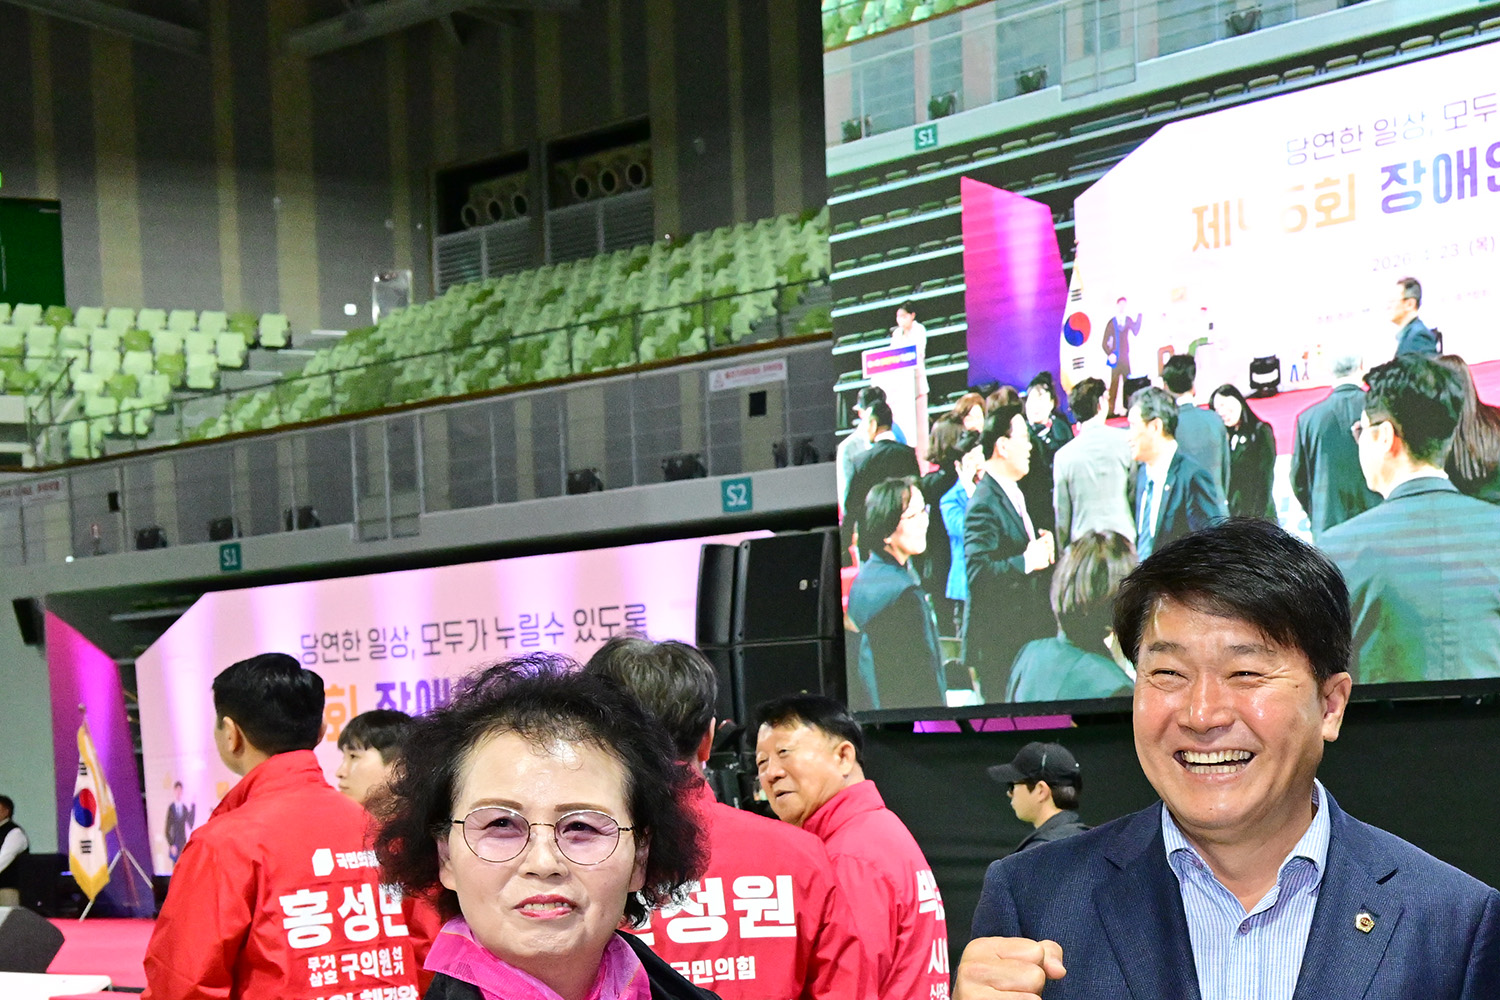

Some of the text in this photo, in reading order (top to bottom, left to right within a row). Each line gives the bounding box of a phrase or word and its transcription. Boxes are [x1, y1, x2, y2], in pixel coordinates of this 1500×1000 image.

[1286, 124, 1364, 166] 당연한
[1373, 111, 1433, 148] 일상,
[726, 483, 748, 507] S2
[223, 547, 238, 567] S1
[300, 629, 361, 665] 당연한
[367, 626, 415, 661] 일상,
[421, 617, 488, 657] 모두가
[494, 611, 565, 649] 누릴수
